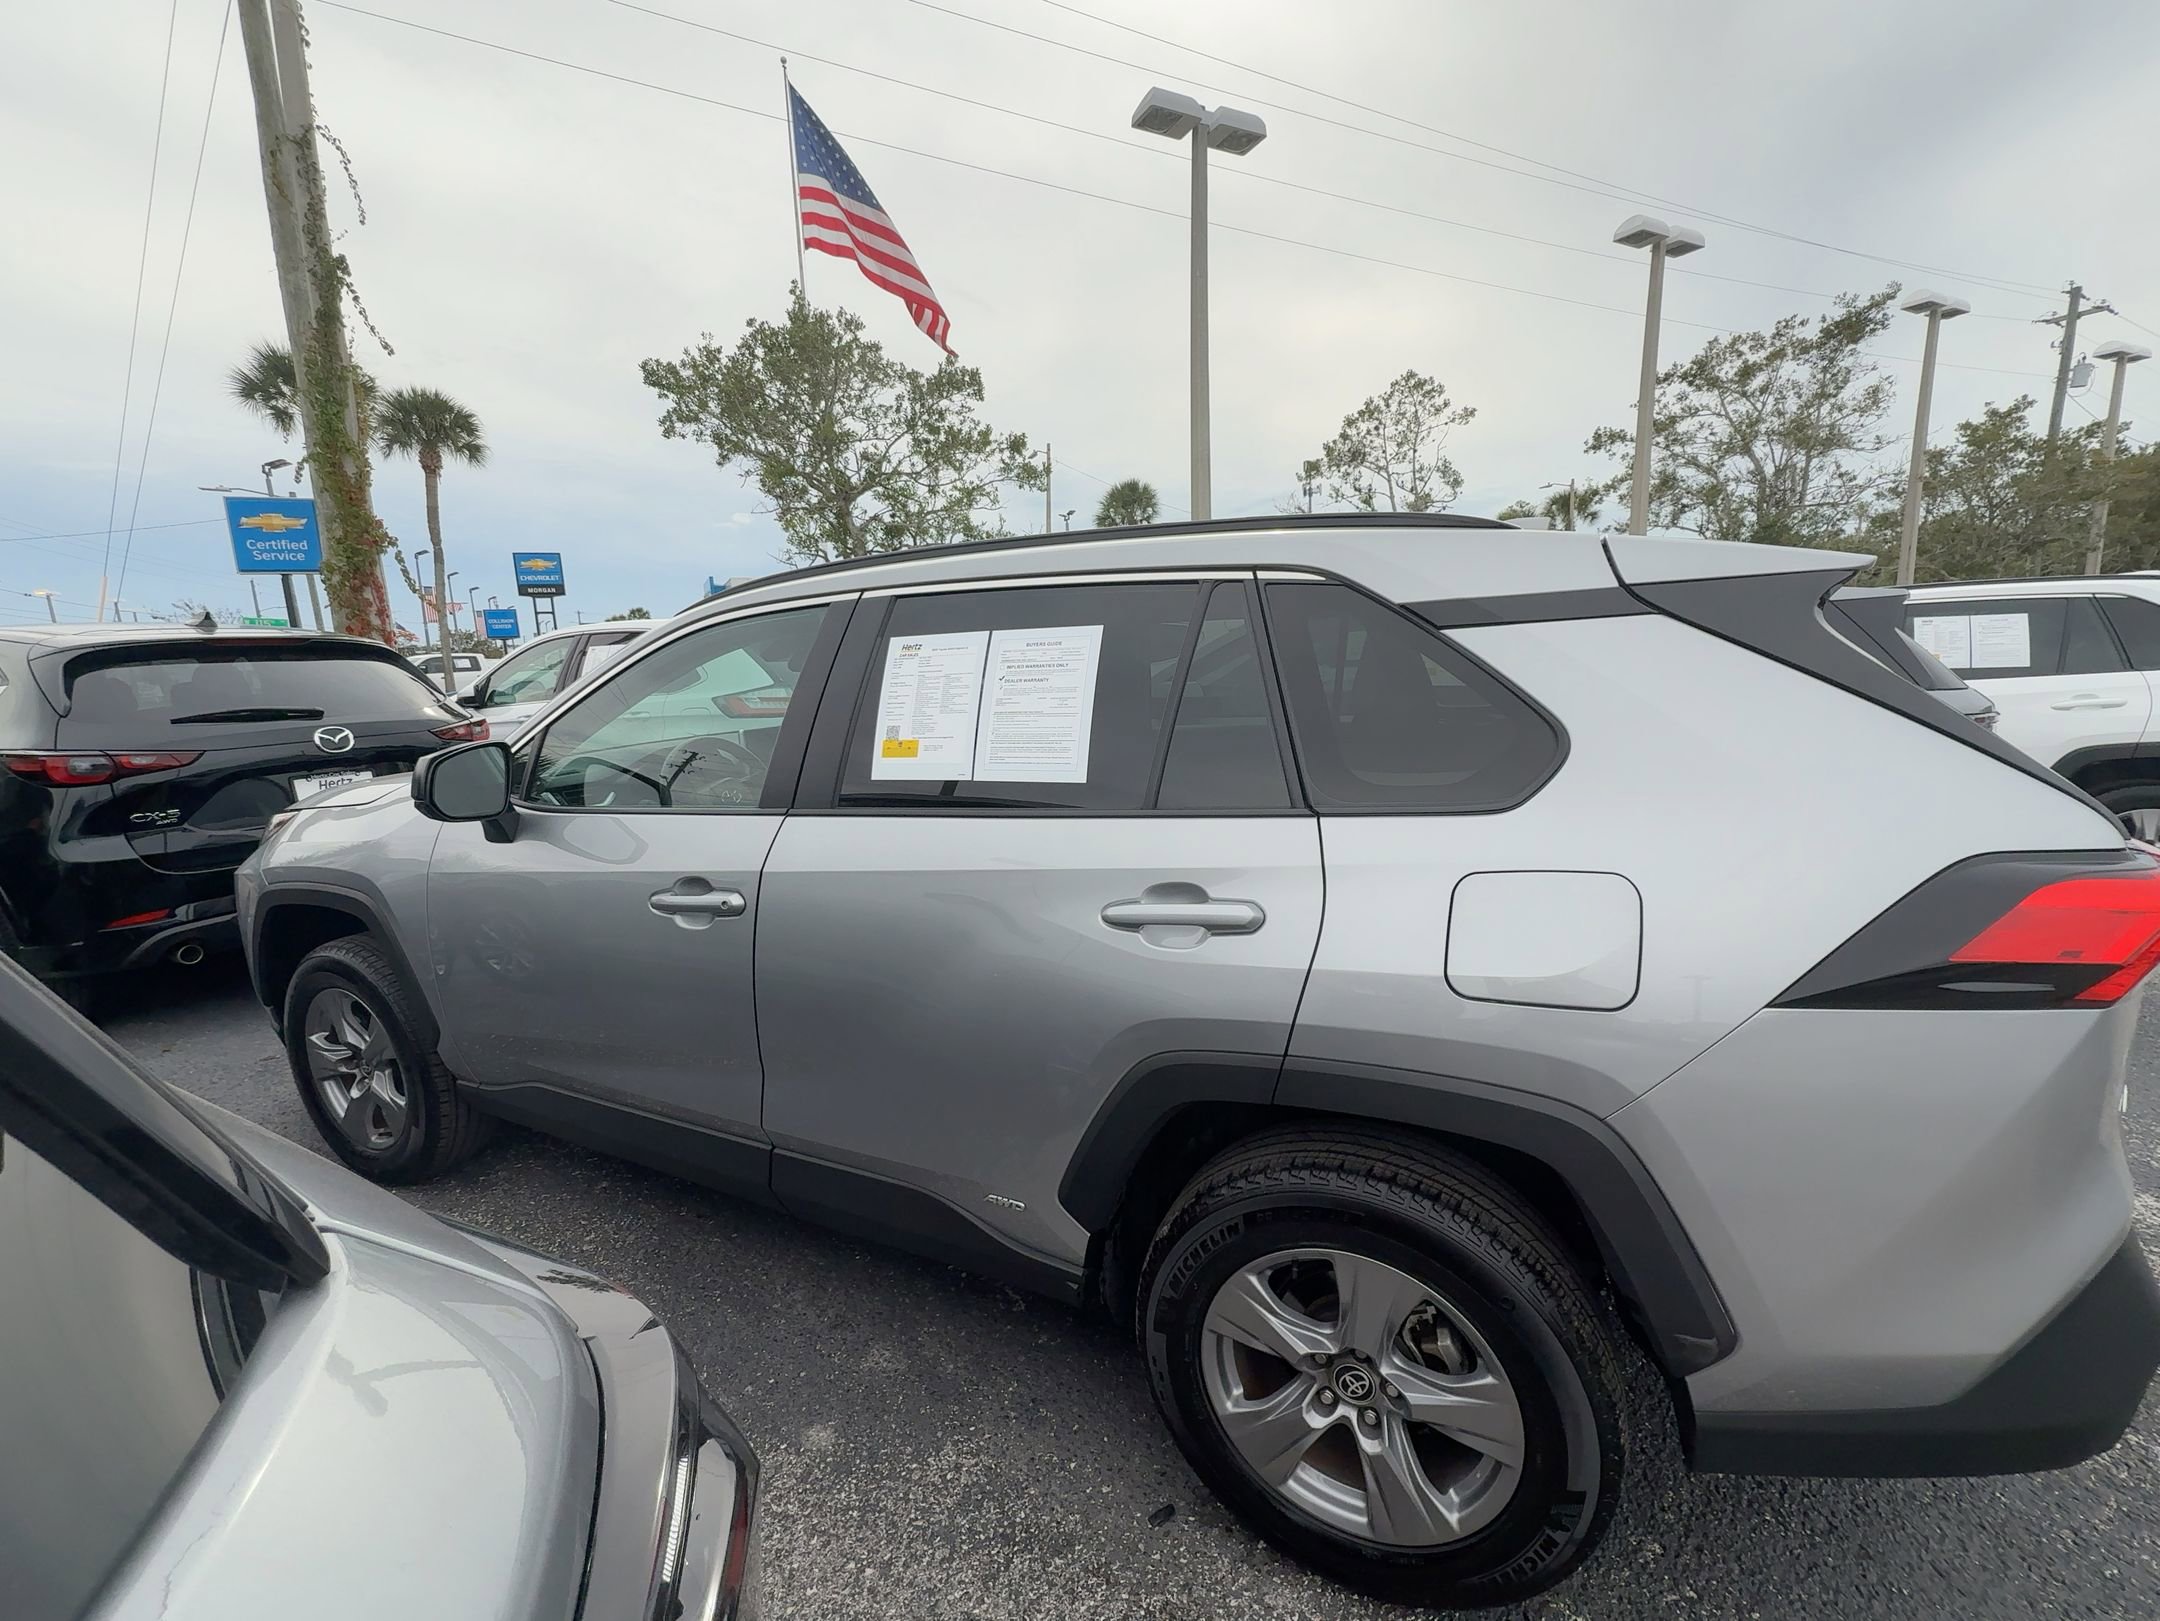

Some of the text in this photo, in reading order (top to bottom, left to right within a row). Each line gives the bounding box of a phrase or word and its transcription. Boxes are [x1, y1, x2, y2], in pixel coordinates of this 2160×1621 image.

[246, 539, 308, 550] Certified
[252, 550, 305, 561] Service
[901, 643, 923, 651] Hertz
[319, 778, 353, 790] Hertz
[129, 809, 180, 822] CX-5
[1168, 1221, 1241, 1297] MICHELIN
